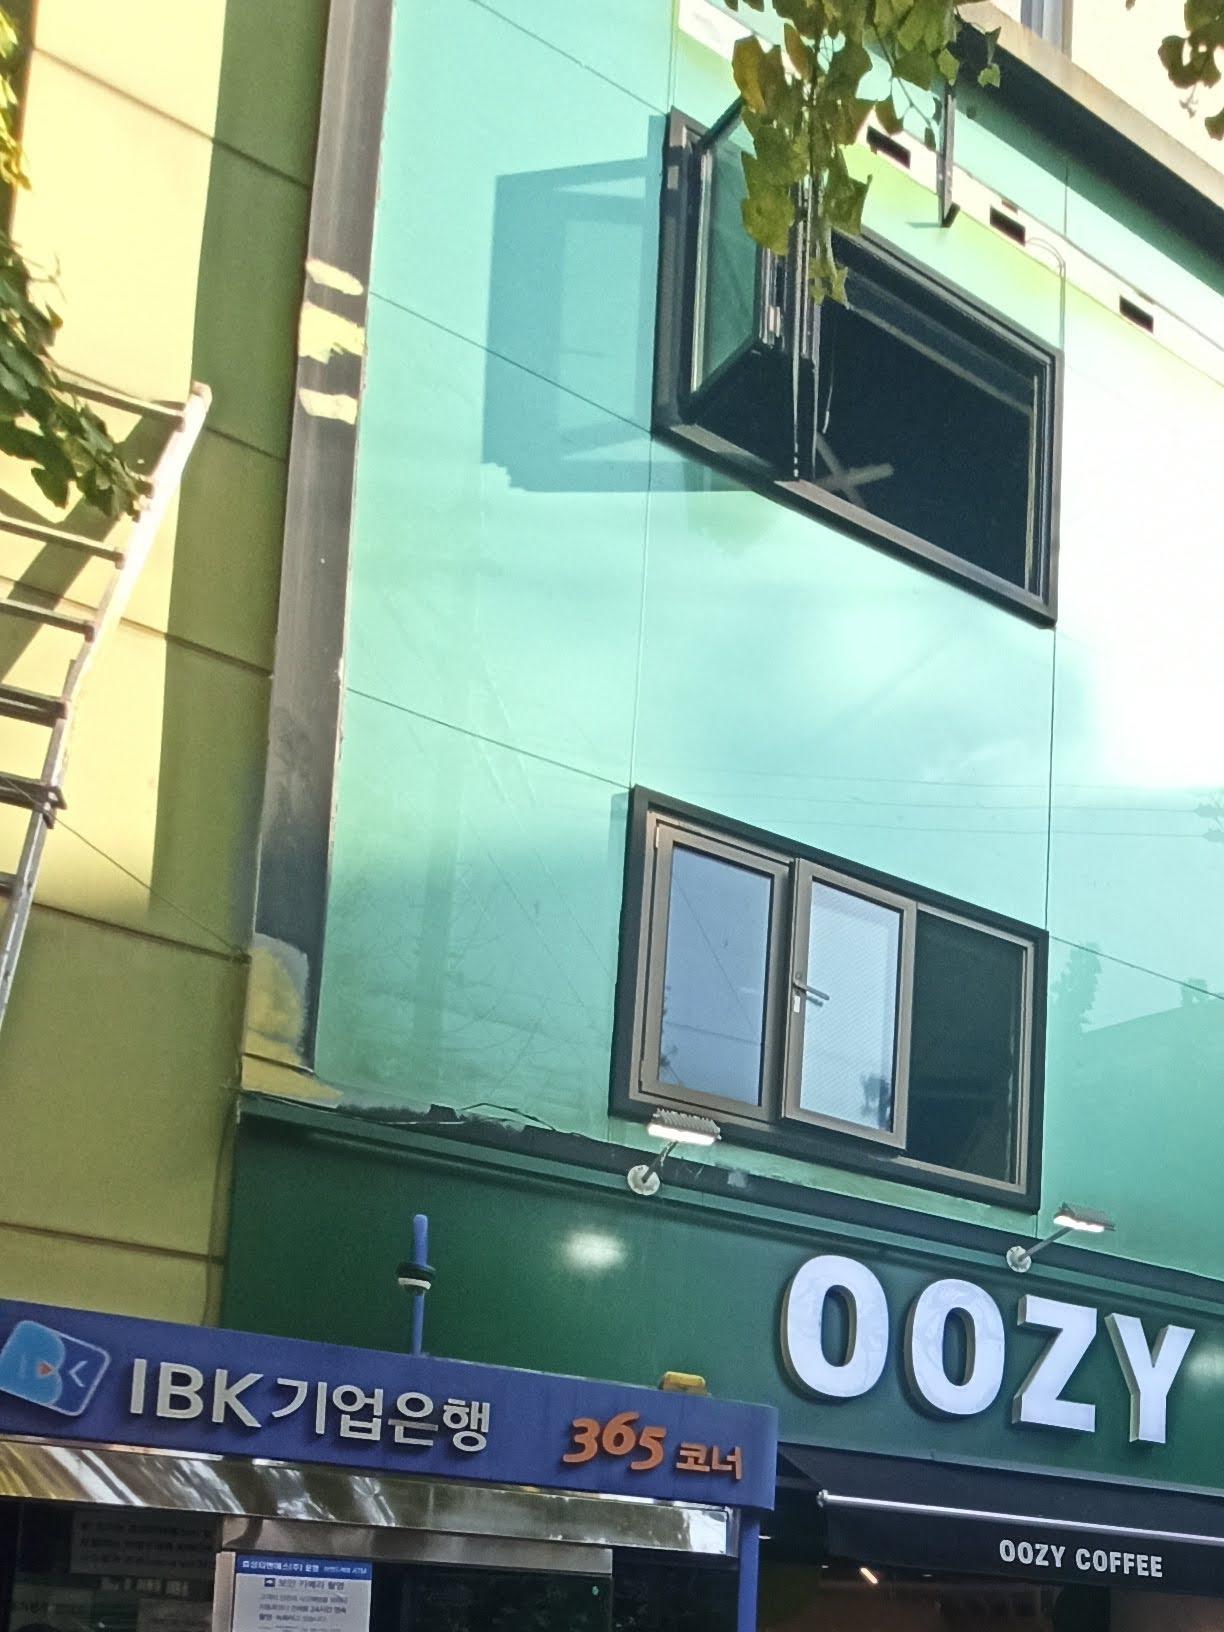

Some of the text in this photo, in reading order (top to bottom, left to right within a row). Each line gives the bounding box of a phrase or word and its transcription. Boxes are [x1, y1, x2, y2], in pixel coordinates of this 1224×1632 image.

[781, 1254, 1195, 1443] OOZY
[562, 1411, 743, 1480] 365 코너
[999, 1539, 1163, 1578] OOZY COFFEE
